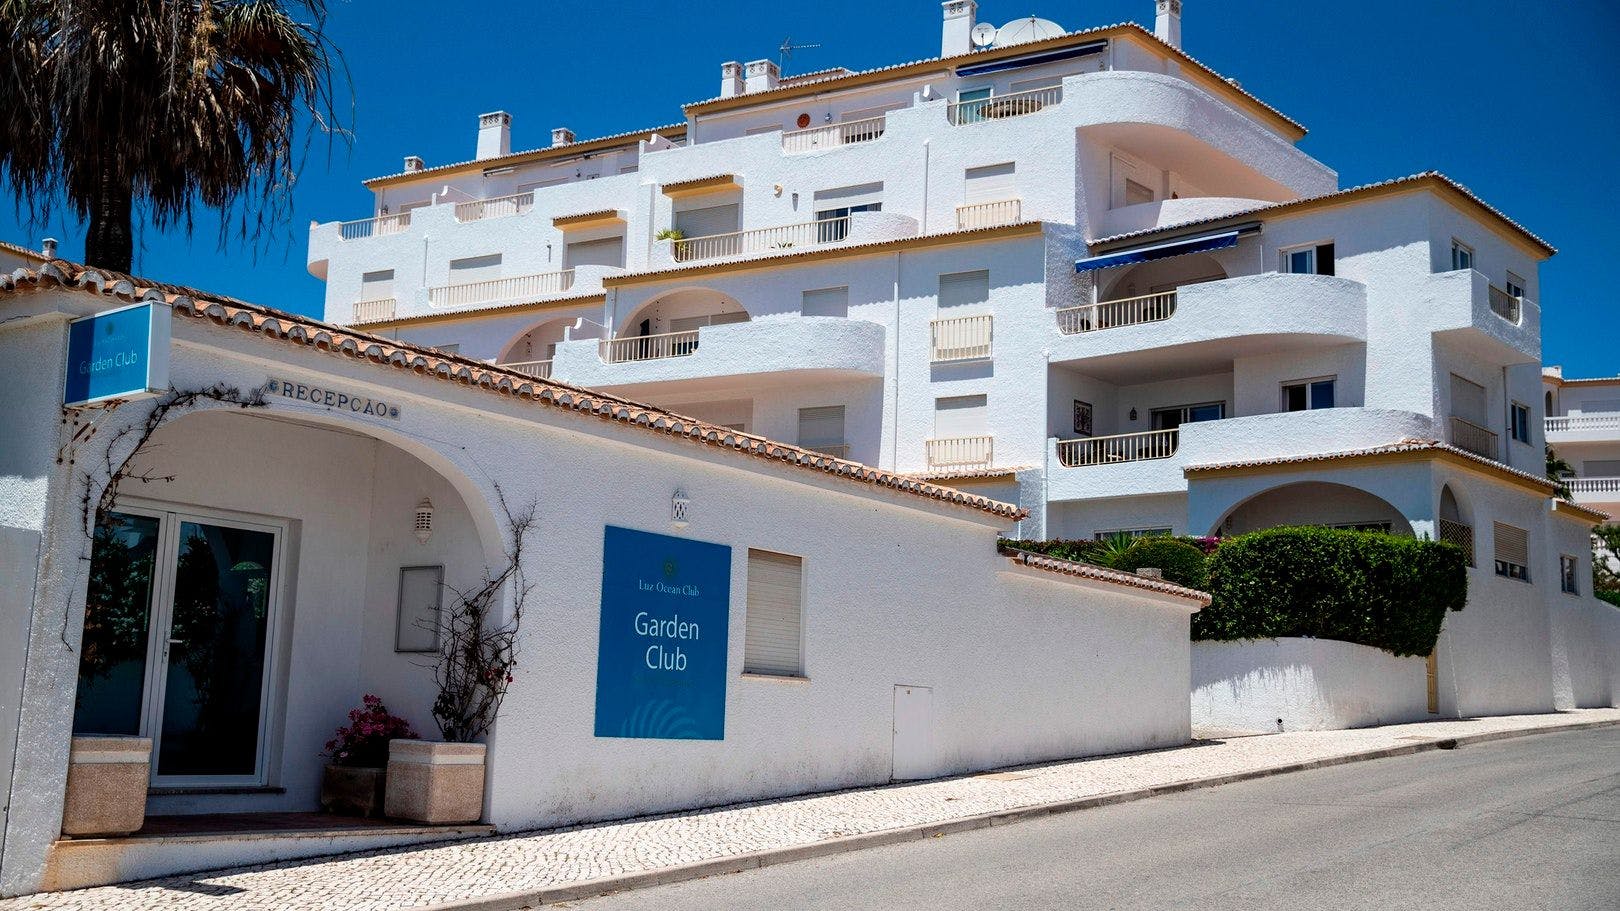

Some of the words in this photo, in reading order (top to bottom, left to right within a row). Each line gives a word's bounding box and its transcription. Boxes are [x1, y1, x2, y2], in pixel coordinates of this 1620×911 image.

[80, 355, 113, 374] Garden
[115, 349, 138, 367] Club
[638, 578, 655, 592] Luz
[656, 581, 681, 596] Ocean
[682, 584, 700, 597] Club
[634, 611, 700, 640] Garden
[645, 644, 687, 671] Club
